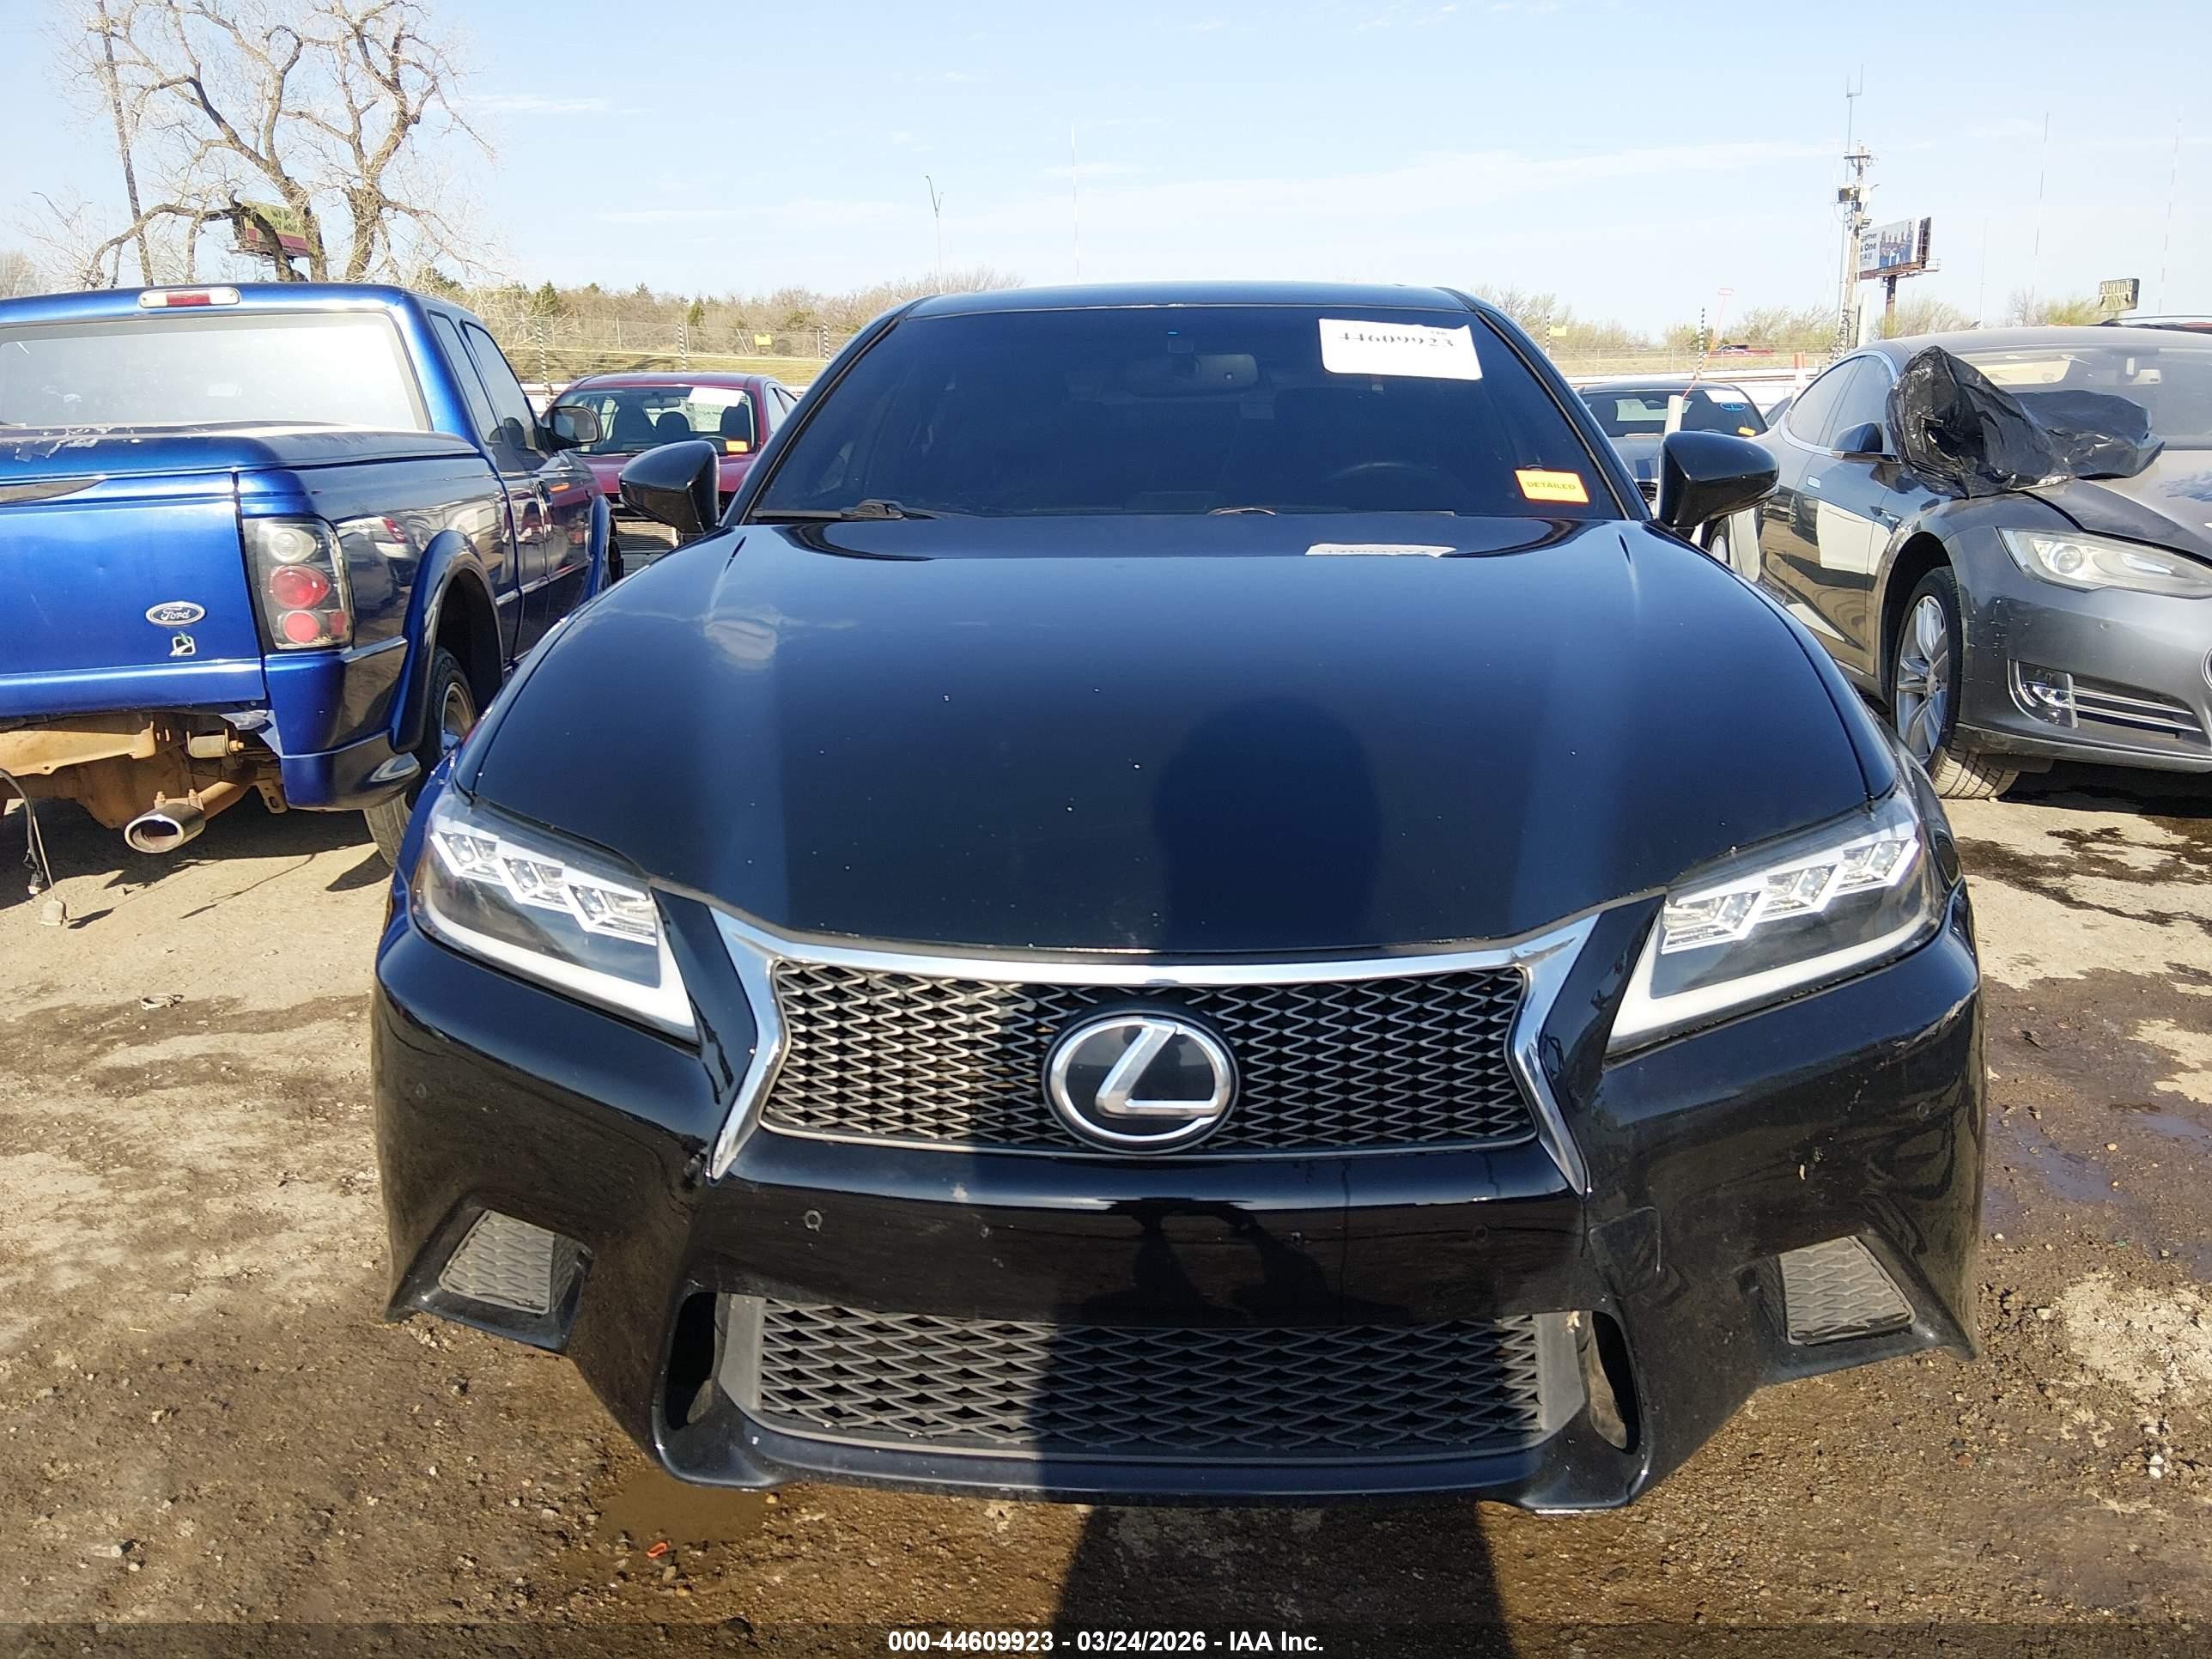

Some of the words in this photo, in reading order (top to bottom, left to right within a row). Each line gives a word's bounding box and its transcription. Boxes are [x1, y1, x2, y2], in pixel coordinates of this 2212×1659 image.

[1864, 243, 1877, 252] One
[2100, 280, 2133, 295] EXECUTIVE
[1339, 332, 1454, 347] 44609923
[1526, 481, 1577, 490] DETAILED
[160, 606, 191, 622] Ford
